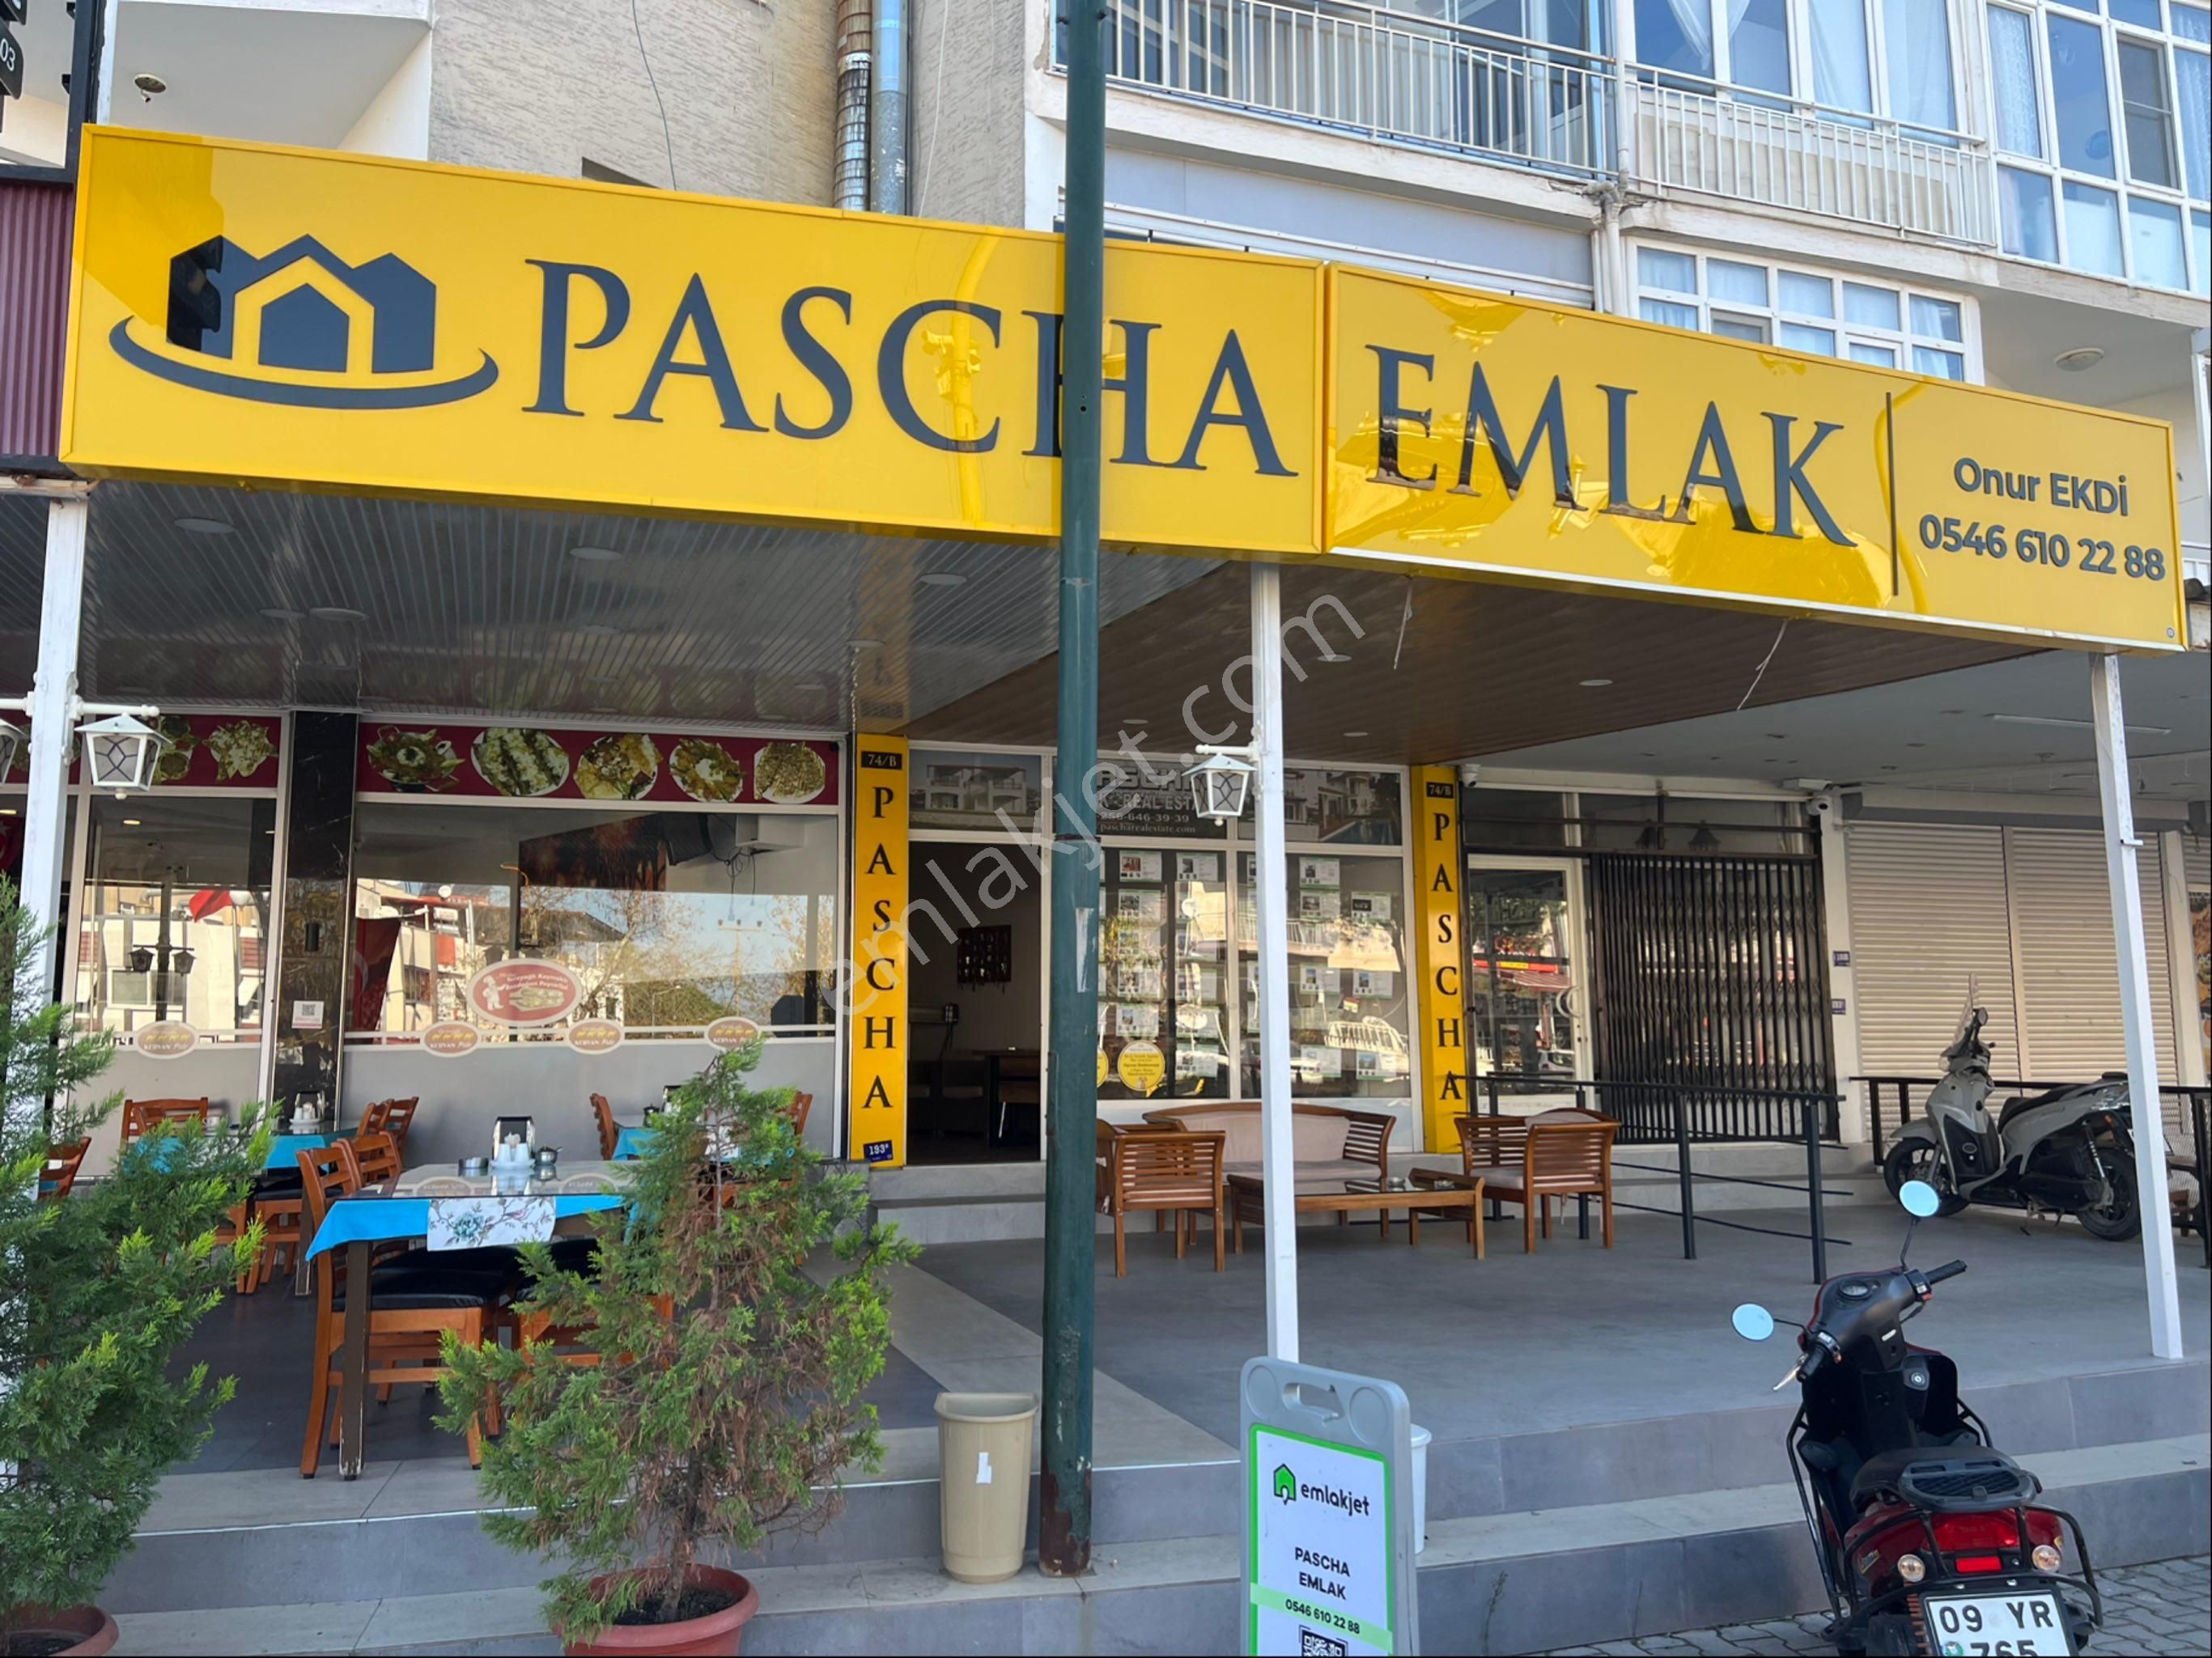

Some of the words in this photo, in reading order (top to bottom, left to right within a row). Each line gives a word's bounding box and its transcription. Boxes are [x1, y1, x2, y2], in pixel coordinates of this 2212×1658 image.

[522, 258, 1300, 477] PASCHA
[1365, 343, 1857, 548] EMLAK
[1954, 457, 2040, 502] Onur
[2050, 471, 2129, 516] EKDİ
[1919, 514, 2008, 559] 0546
[2016, 528, 2070, 568] 610
[2078, 538, 2117, 575] 22
[2125, 545, 2166, 582] 88
[868, 753, 897, 767] 74/B
[863, 786, 897, 1109] PASCHA
[1431, 812, 1463, 1101] PASCHA
[1301, 1483, 1369, 1516] emlakjet
[1295, 1546, 1350, 1577] PASCHA
[1299, 1571, 1346, 1600] EMLAK
[1285, 1599, 1312, 1617] 0546
[1314, 1608, 1331, 1623] 610
[1334, 1615, 1346, 1629] 22
[1348, 1620, 1361, 1635] 88
[1939, 1605, 1982, 1633] 09
[2006, 1601, 2053, 1629] YR
